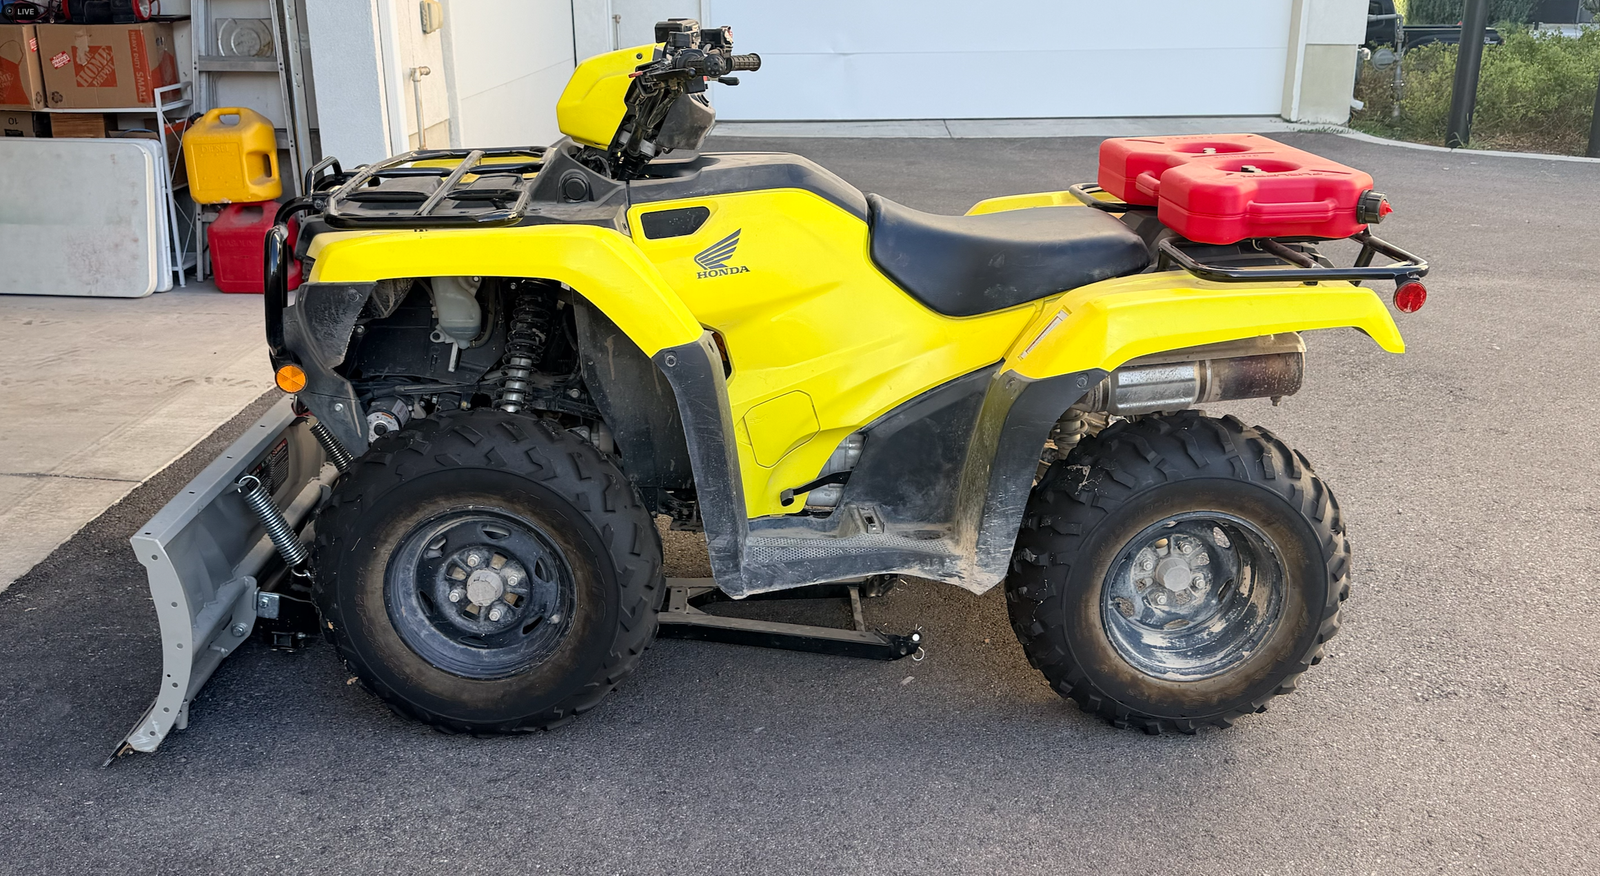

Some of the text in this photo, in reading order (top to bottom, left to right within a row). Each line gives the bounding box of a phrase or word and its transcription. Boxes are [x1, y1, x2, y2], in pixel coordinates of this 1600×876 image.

[76, 46, 113, 87] HOME
[92, 61, 116, 87] DEPOT
[130, 31, 148, 101] HEAVY DUTY SMALL
[697, 265, 750, 279] HONDA
